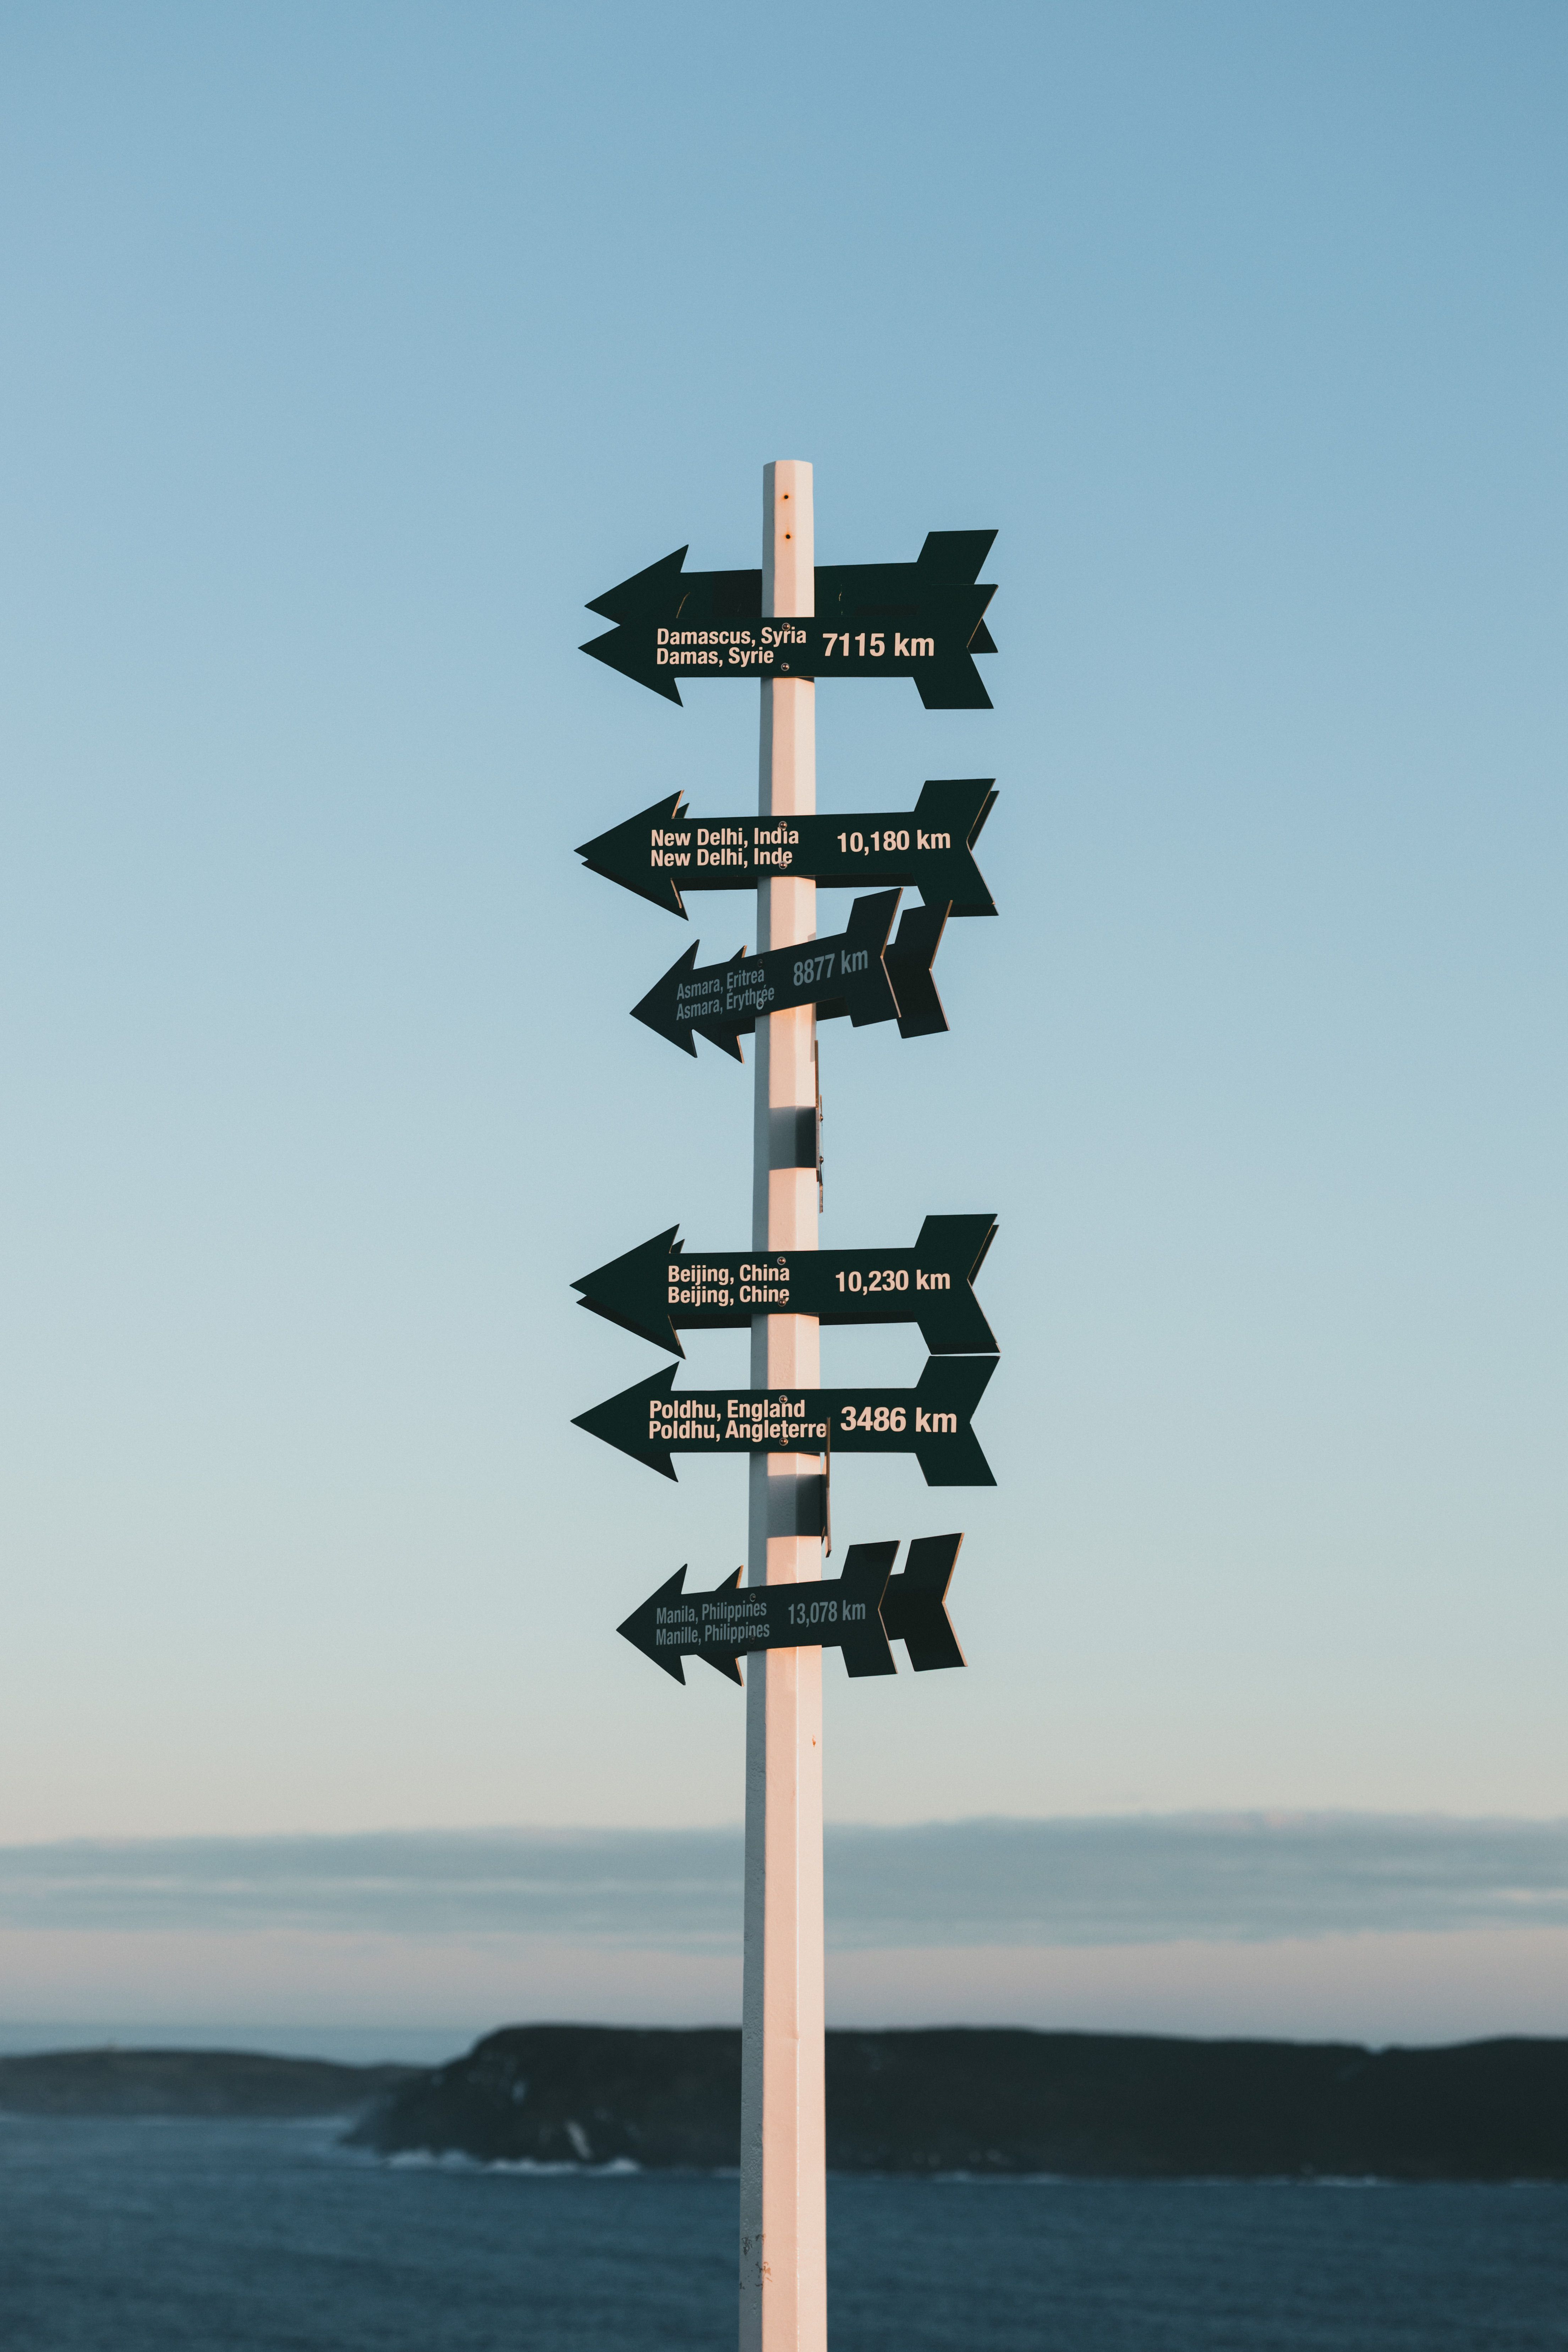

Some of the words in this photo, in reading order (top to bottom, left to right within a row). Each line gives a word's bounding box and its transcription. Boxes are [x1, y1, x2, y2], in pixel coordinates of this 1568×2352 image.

[658, 629, 755, 647] Damascus,
[761, 627, 806, 647] Syria
[823, 633, 885, 656] 7115
[895, 633, 934, 656] km
[657, 648, 723, 667] Damas,
[729, 647, 773, 667] Syrie
[652, 830, 691, 846] New
[698, 828, 747, 848] Delhi,
[755, 827, 799, 845] India
[838, 830, 909, 855] 10,180
[917, 830, 950, 849] km
[651, 850, 691, 866] New
[697, 848, 747, 868] Delhi,
[755, 848, 793, 865] Inde
[794, 953, 834, 986] 8877
[841, 950, 867, 974] km
[677, 979, 723, 1000] Asmara,
[727, 969, 764, 989] Eritrea
[676, 999, 722, 1020] Asmara,
[727, 985, 774, 1011] Érythrée
[669, 1265, 734, 1285] Beijing,
[740, 1264, 789, 1281] China
[836, 1270, 908, 1295] 10,230
[917, 1270, 950, 1289] km
[669, 1286, 734, 1306] Beijing,
[740, 1285, 789, 1302] Chine
[650, 1400, 720, 1421] Poldhu,
[728, 1399, 805, 1421] England
[841, 1407, 906, 1431] 3486
[916, 1408, 956, 1432] km
[649, 1421, 720, 1442] Poldhu,
[726, 1420, 826, 1442] Angleterre
[657, 1606, 698, 1624] Manila,
[702, 1600, 767, 1622] Philippines
[789, 1601, 837, 1627] 13,078
[843, 1600, 865, 1621] km
[656, 1628, 701, 1645] Manille,
[705, 1622, 769, 1643] Philippines
